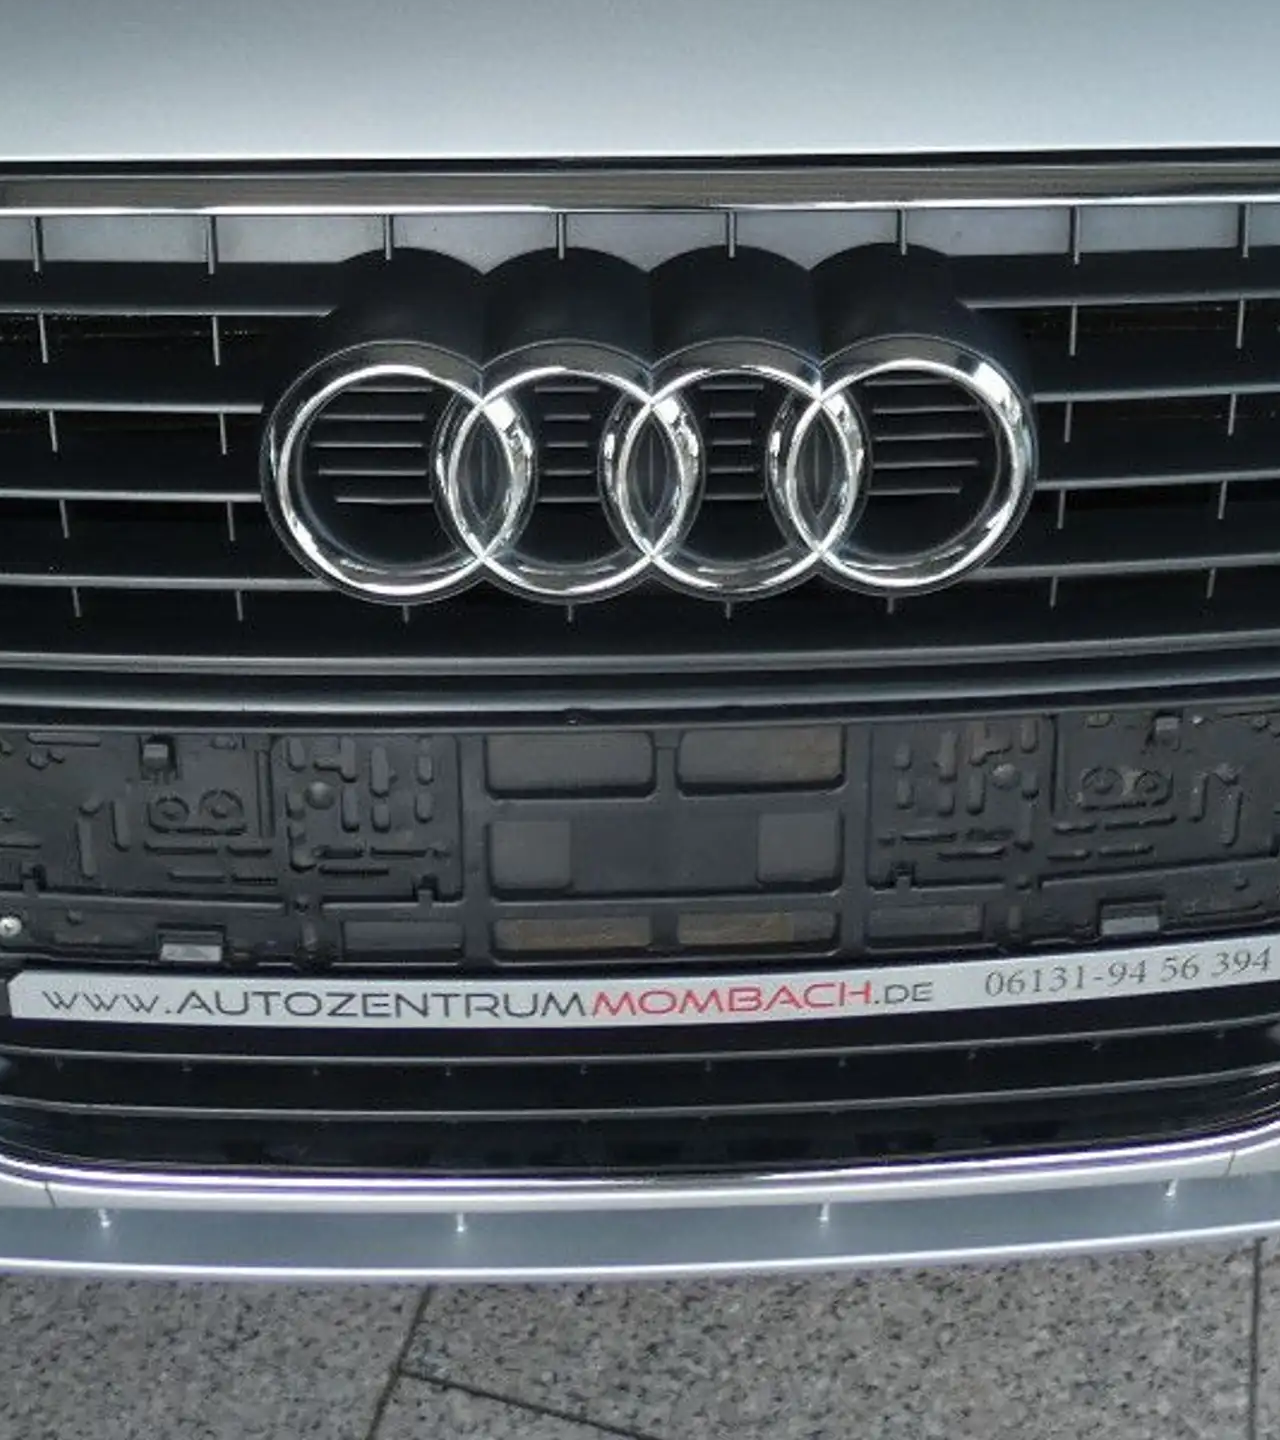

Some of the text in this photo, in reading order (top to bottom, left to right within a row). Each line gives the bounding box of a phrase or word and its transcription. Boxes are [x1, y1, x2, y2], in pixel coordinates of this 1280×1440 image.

[984, 959, 1146, 997] 06131-94
[1159, 956, 1200, 983] 56
[1210, 945, 1272, 976] 394
